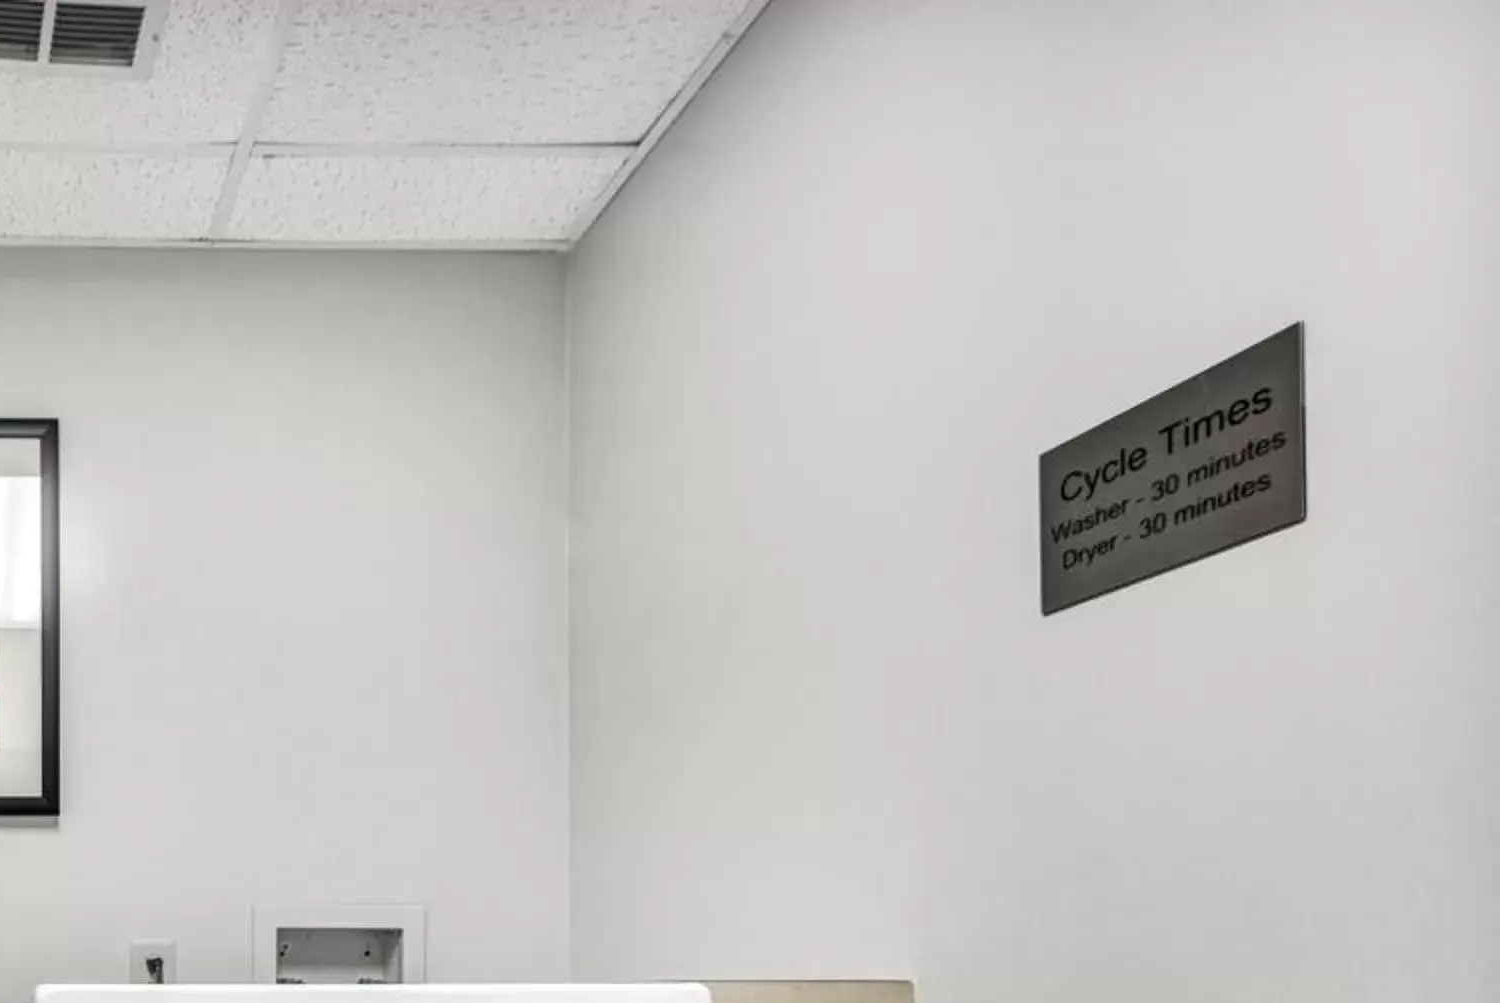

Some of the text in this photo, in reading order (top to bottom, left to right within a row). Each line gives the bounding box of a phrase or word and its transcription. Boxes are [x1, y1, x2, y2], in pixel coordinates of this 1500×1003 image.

[1051, 498, 1129, 544] Washer
[1151, 474, 1180, 502] 30
[1186, 431, 1288, 488] minutes
[1060, 387, 1274, 501] Cycle Times
[1062, 535, 1118, 571] Dryer
[1139, 512, 1167, 540] 30
[1173, 473, 1273, 526] minutes
